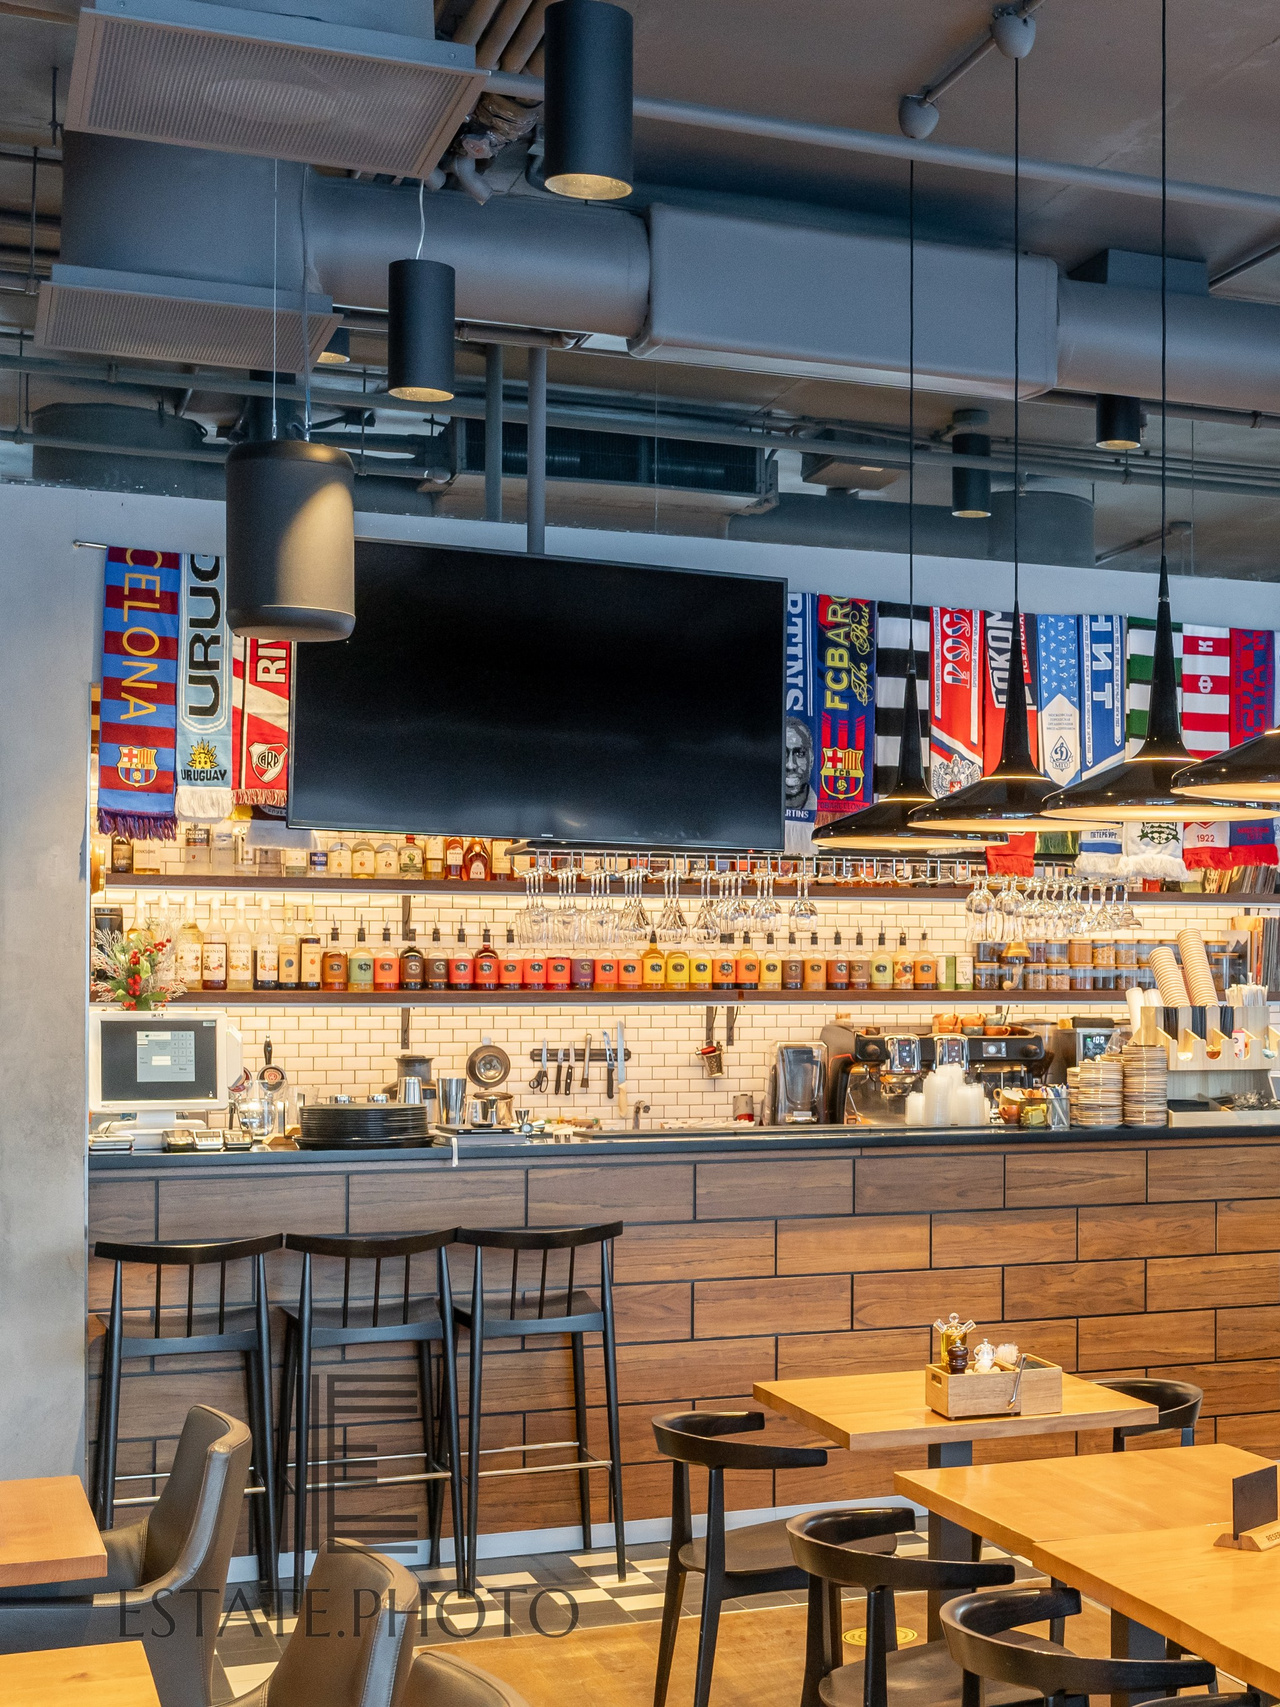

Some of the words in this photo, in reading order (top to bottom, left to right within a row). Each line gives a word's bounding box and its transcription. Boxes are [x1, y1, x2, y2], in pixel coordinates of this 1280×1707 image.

[942, 607, 971, 689] РОС
[1242, 664, 1265, 742] СКА
[181, 769, 227, 782] URUGUAY
[1197, 834, 1215, 843] 1922
